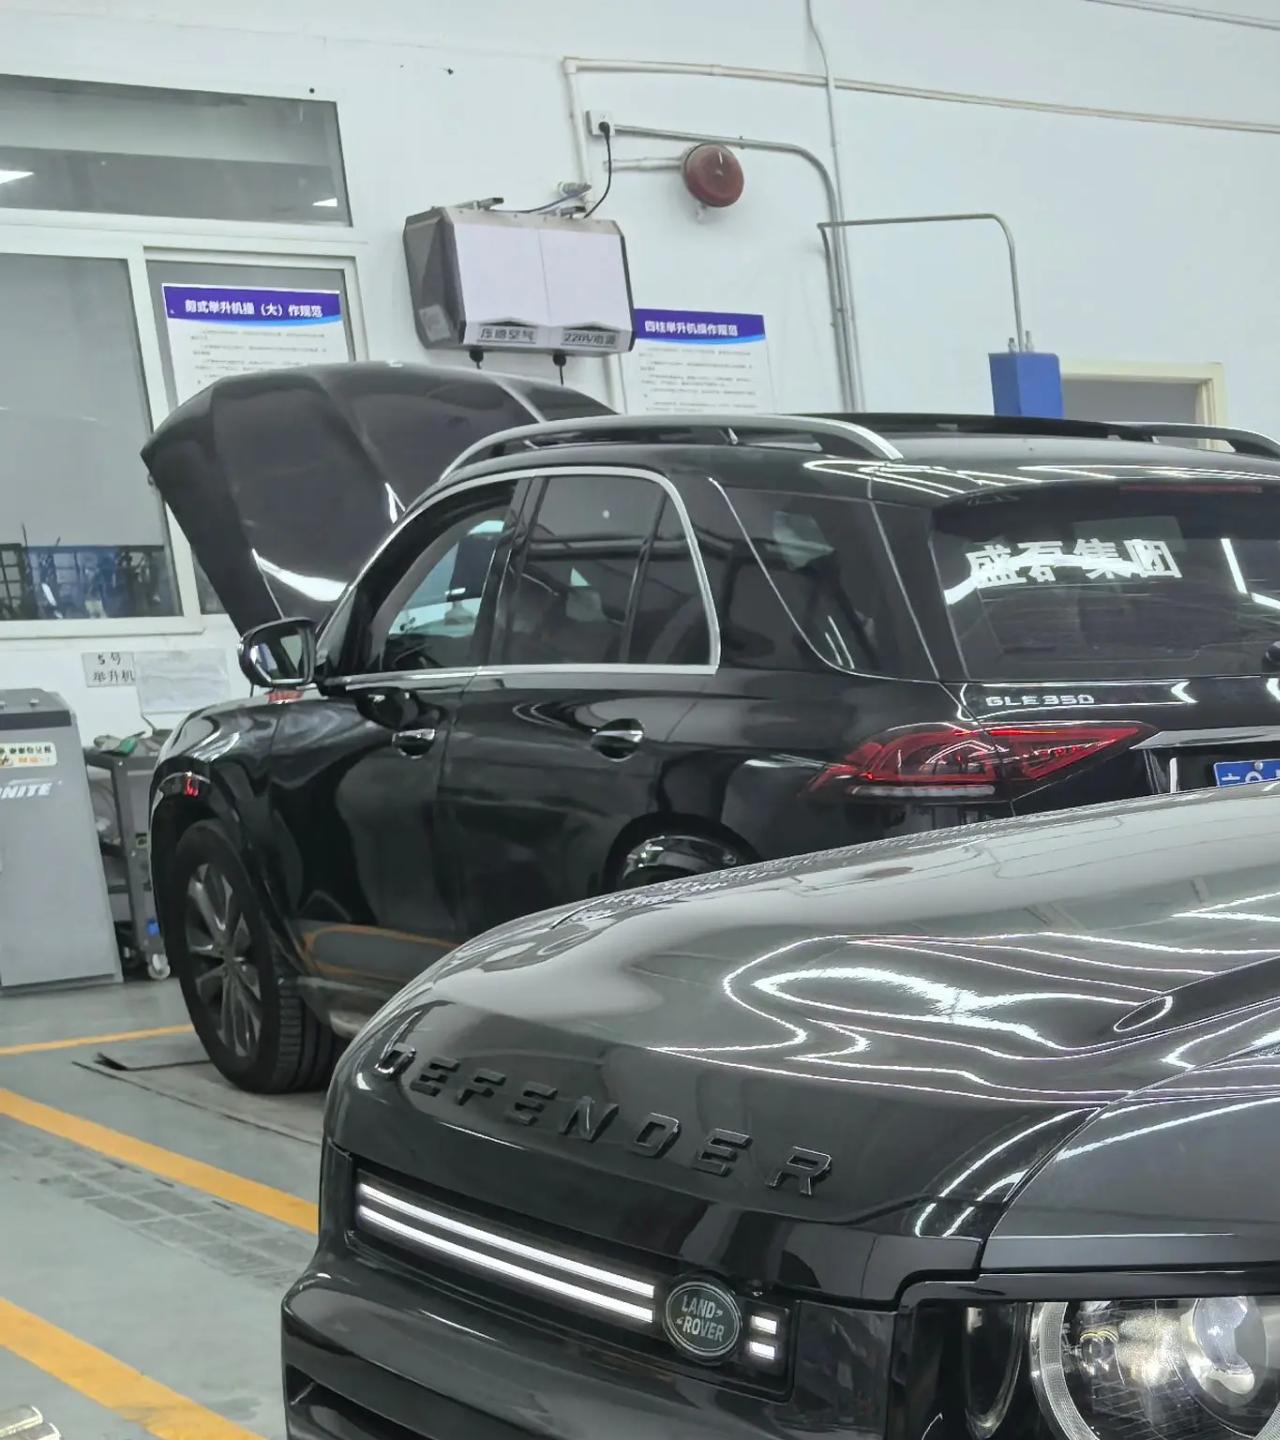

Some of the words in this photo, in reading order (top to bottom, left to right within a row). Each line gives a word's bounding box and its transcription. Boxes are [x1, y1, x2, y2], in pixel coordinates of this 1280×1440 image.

[985, 695, 1040, 706] GLE
[1042, 694, 1095, 705] 350
[0, 782, 53, 799] NITE
[374, 1043, 832, 1196] DEFENDER
[681, 1294, 716, 1319] LAND
[682, 1316, 725, 1342] ROVER
